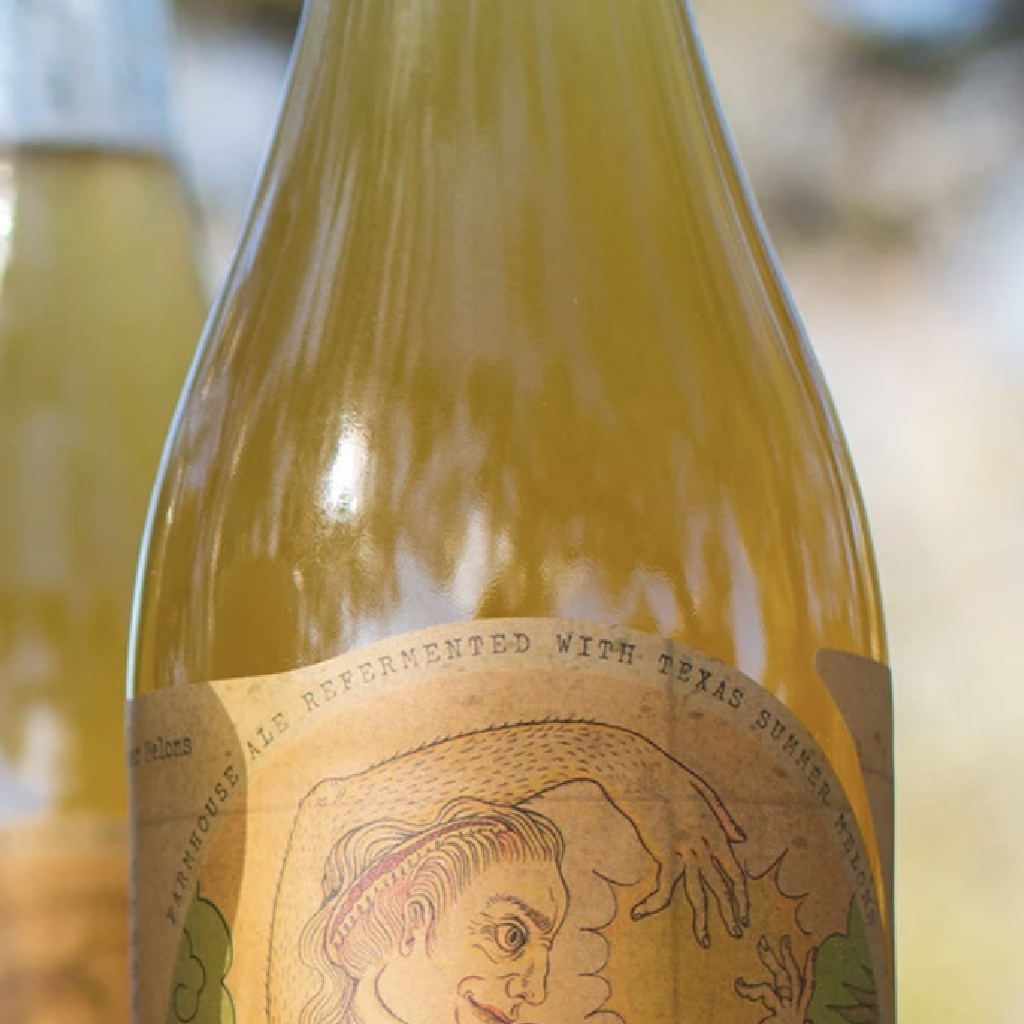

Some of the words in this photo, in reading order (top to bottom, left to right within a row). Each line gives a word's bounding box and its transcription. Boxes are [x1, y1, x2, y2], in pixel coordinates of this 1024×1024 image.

[166, 765, 239, 926] FARMHOUSE
[246, 711, 289, 761] ALE
[301, 632, 531, 713] REFERMENTED
[555, 632, 636, 666] WITH
[658, 652, 744, 709] TEXAS
[754, 708, 832, 806] SUMMER
[833, 812, 877, 927] MELONS
